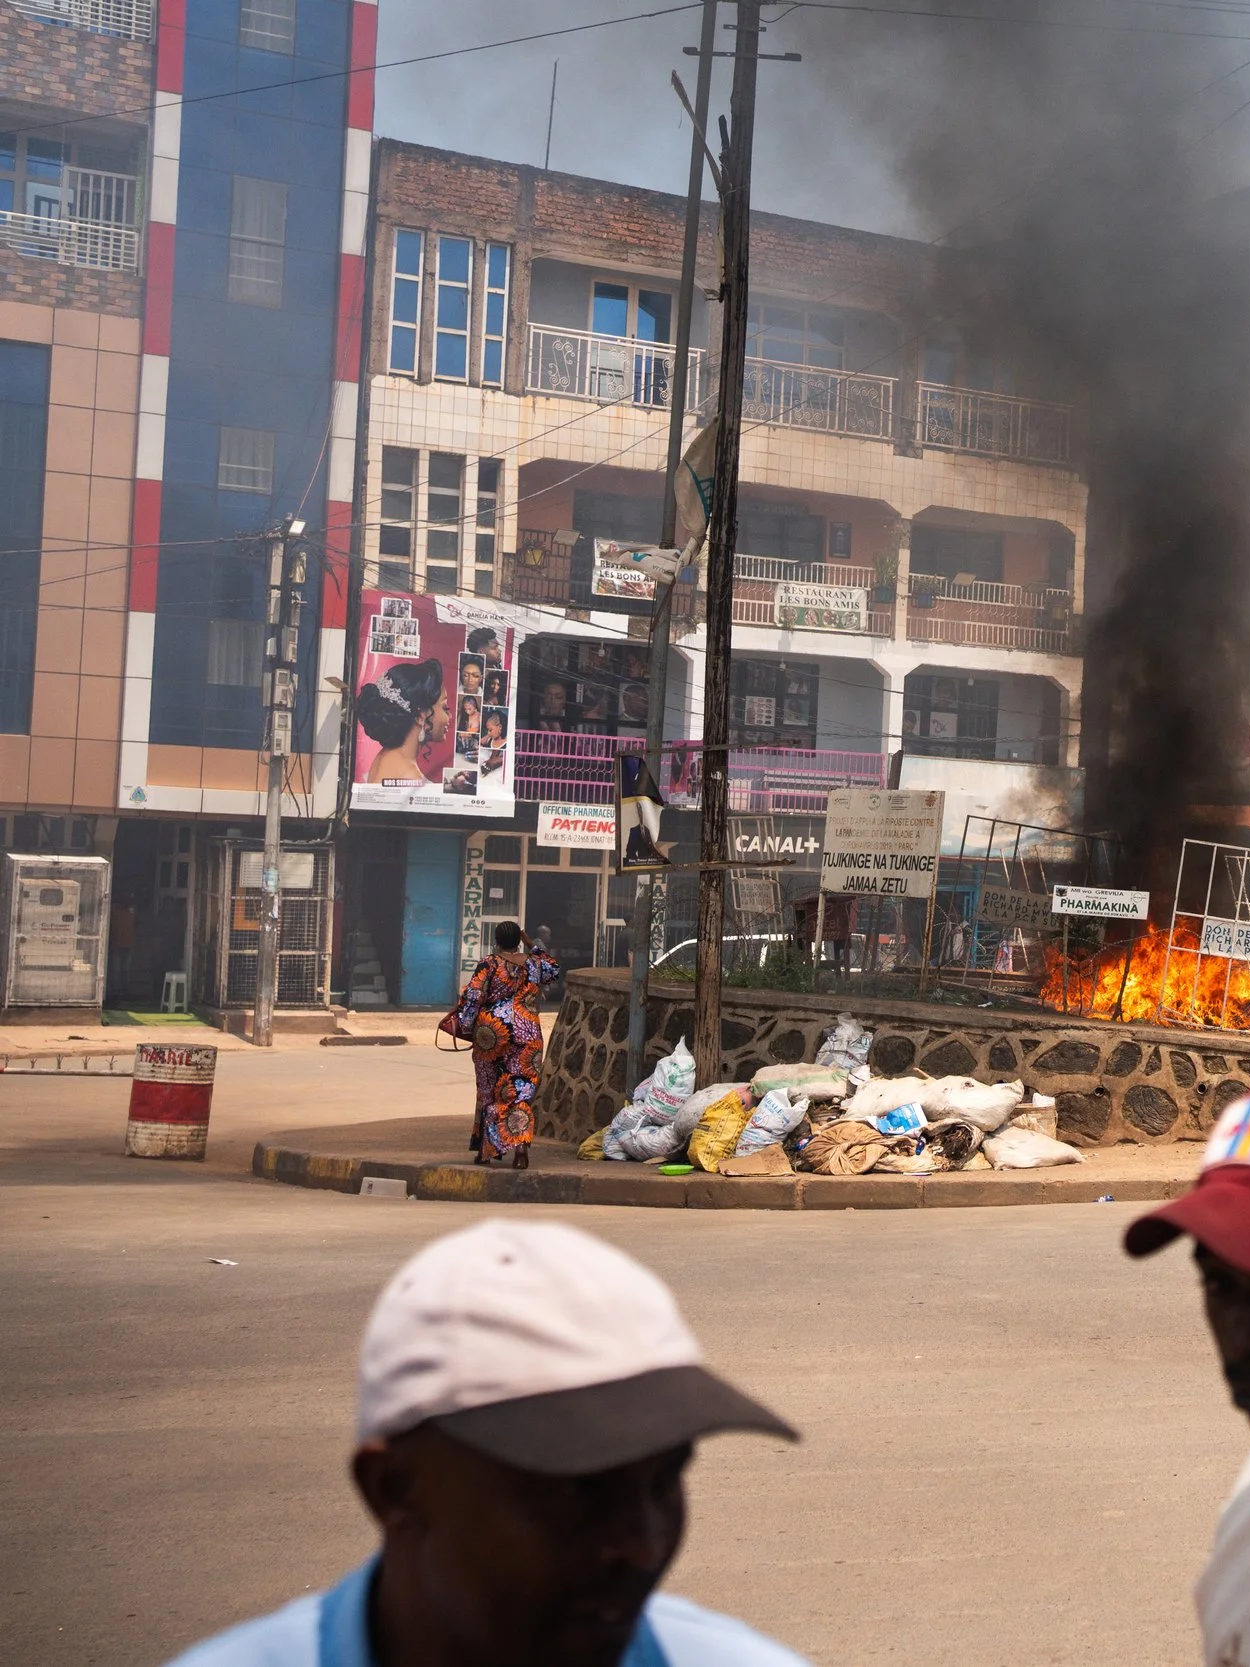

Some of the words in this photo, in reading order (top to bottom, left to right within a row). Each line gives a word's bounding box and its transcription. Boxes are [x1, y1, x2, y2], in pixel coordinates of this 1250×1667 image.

[616, 572, 641, 581] BONS
[784, 586, 854, 600] RESTAURANT
[780, 595, 800, 605] LES
[804, 597, 830, 608] BONS
[833, 600, 860, 609] AMIS
[466, 612, 488, 620] DAHLIA
[542, 806, 572, 816] OFFICINE
[910, 818, 934, 828] CONTRE
[736, 834, 820, 854] CANAL+
[823, 852, 871, 869] TUJIKINGE
[873, 854, 887, 869] NA
[889, 854, 935, 872] TUKINGE
[843, 876, 877, 892] JAMAA
[880, 877, 908, 893] ZETU
[984, 891, 1006, 902] DON
[1010, 896, 1022, 905] DE
[1027, 899, 1038, 908] LA
[1060, 898, 1139, 914] PHARMAKINA
[461, 848, 483, 971] PHARMACIE
[983, 900, 1028, 914] RICHARD
[1205, 925, 1231, 936] DON
[1238, 929, 1250, 938] DE
[1218, 944, 1232, 954] LA
